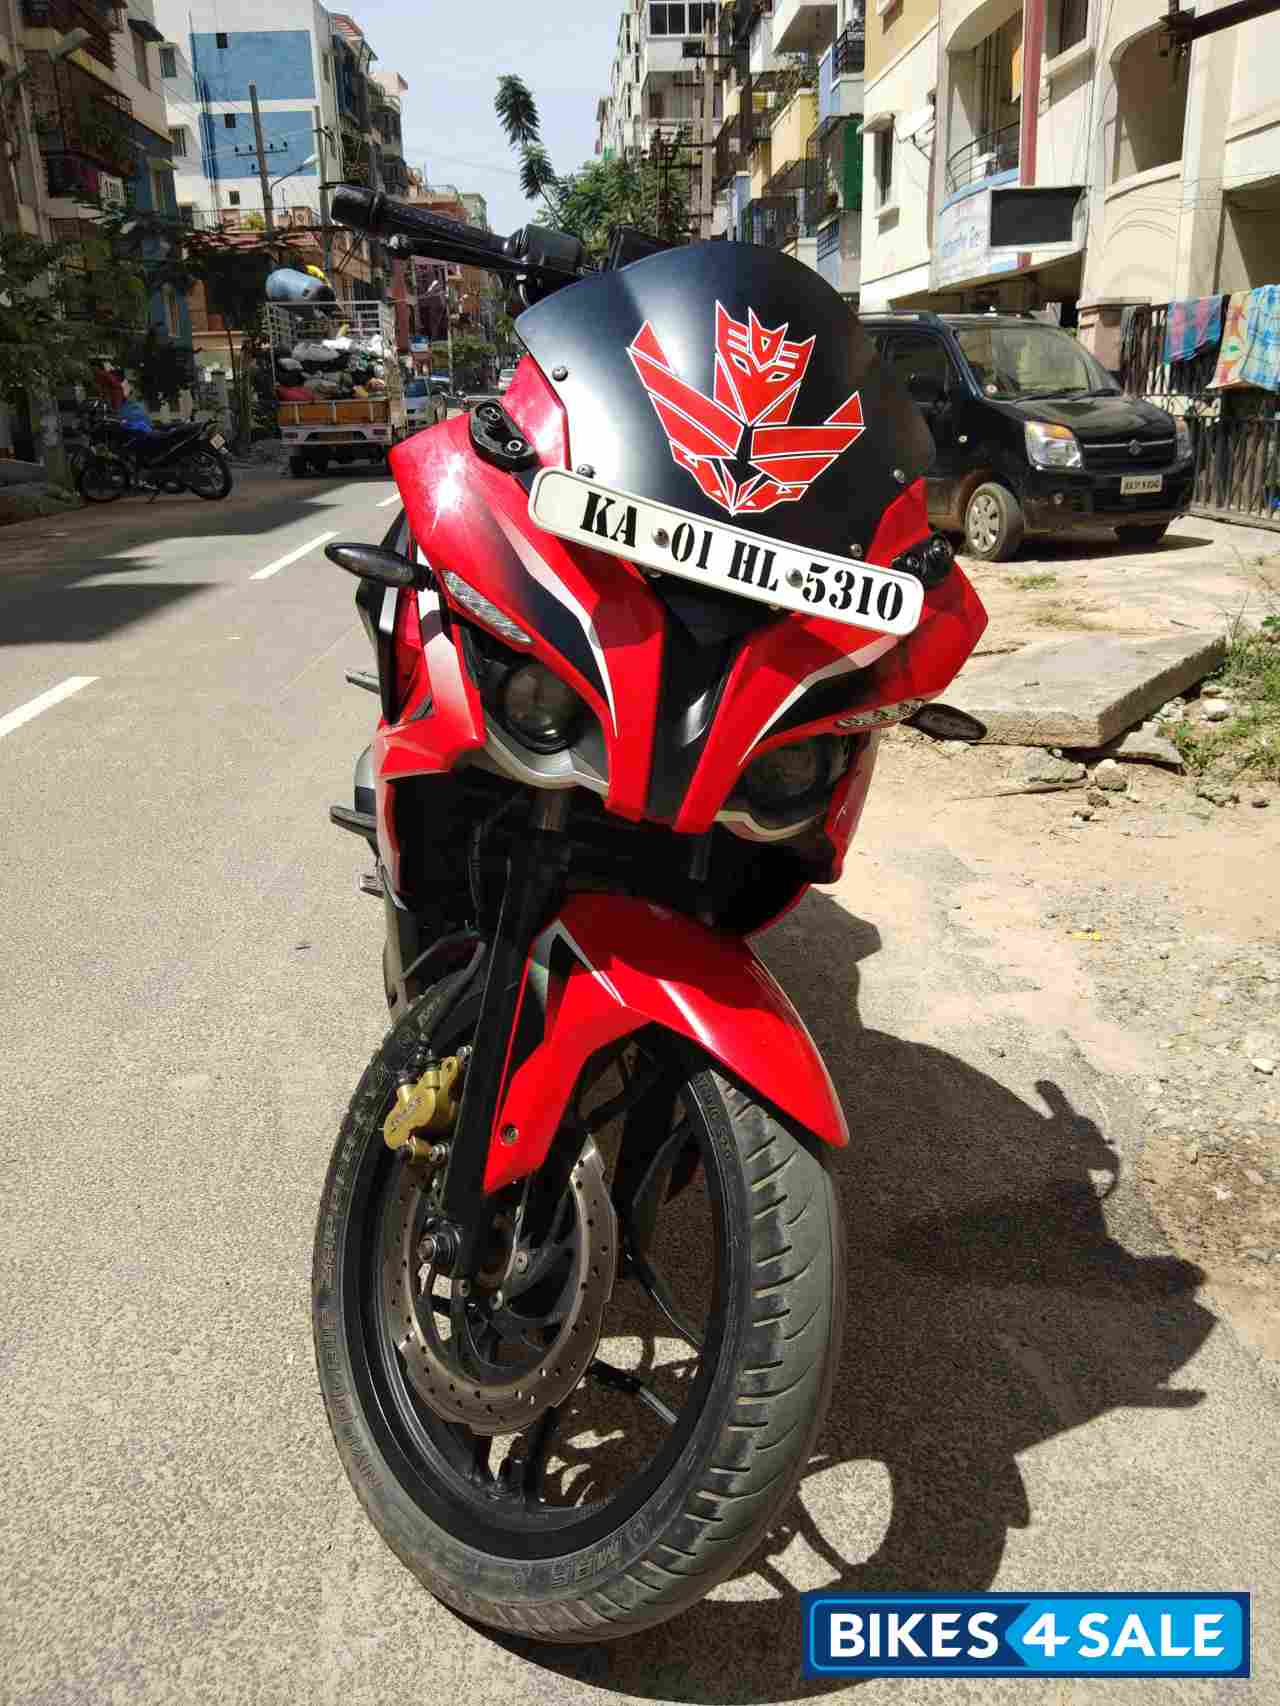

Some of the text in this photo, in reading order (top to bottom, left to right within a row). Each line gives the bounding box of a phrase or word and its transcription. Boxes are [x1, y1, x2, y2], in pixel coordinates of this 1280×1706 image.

[580, 491, 903, 621] KA 01 HL 5310
